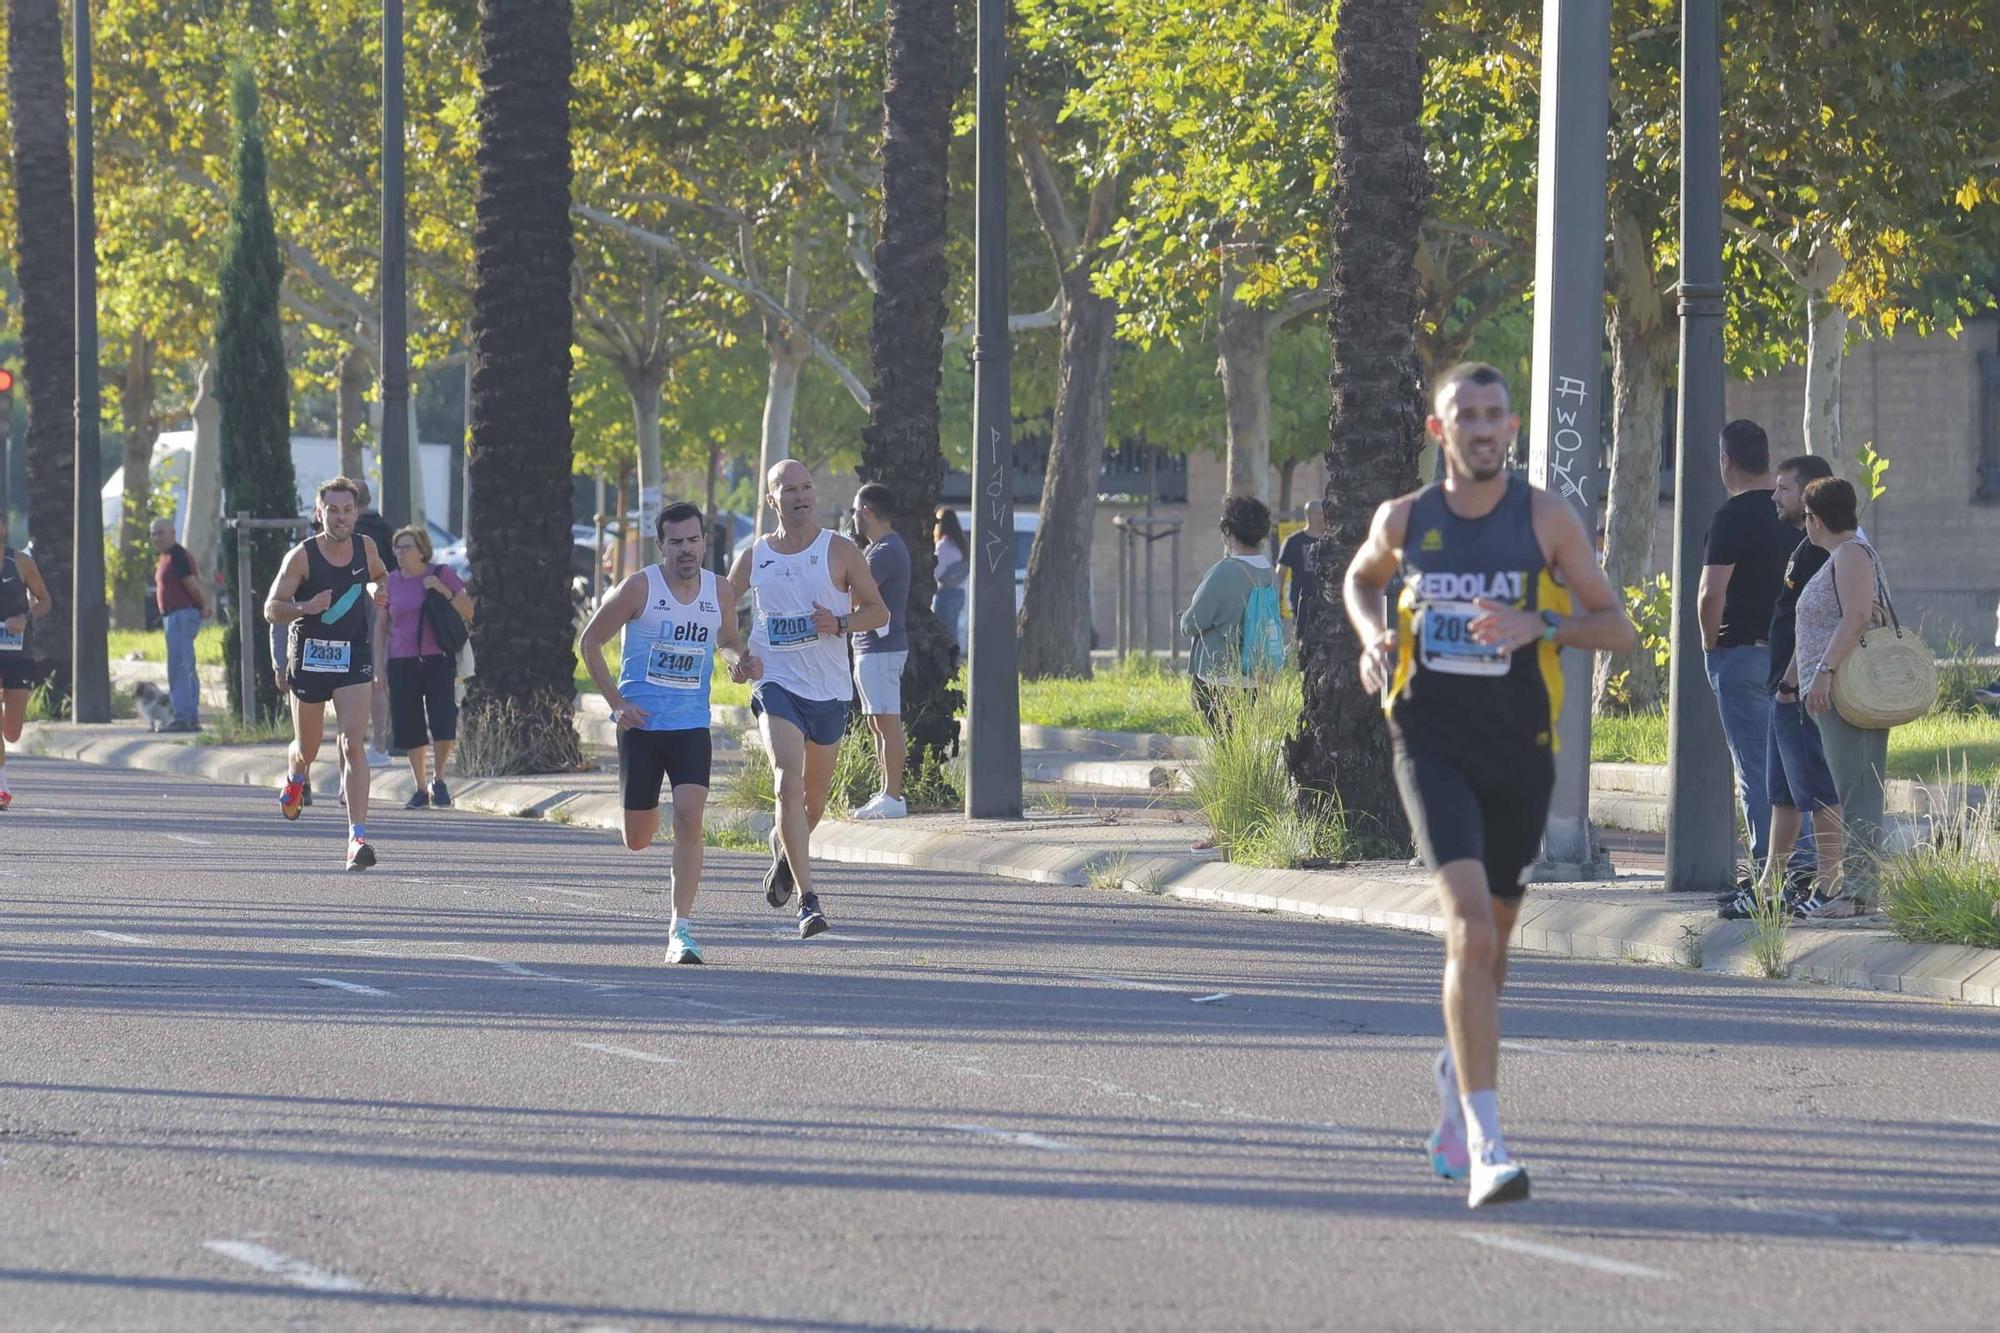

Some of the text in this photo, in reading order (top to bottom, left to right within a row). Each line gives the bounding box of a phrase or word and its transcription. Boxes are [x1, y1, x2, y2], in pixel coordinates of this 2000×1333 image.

[660, 620, 708, 643] Delta
[772, 617, 807, 635] 2200
[310, 646, 342, 660] 2333
[657, 652, 694, 672] 2140
